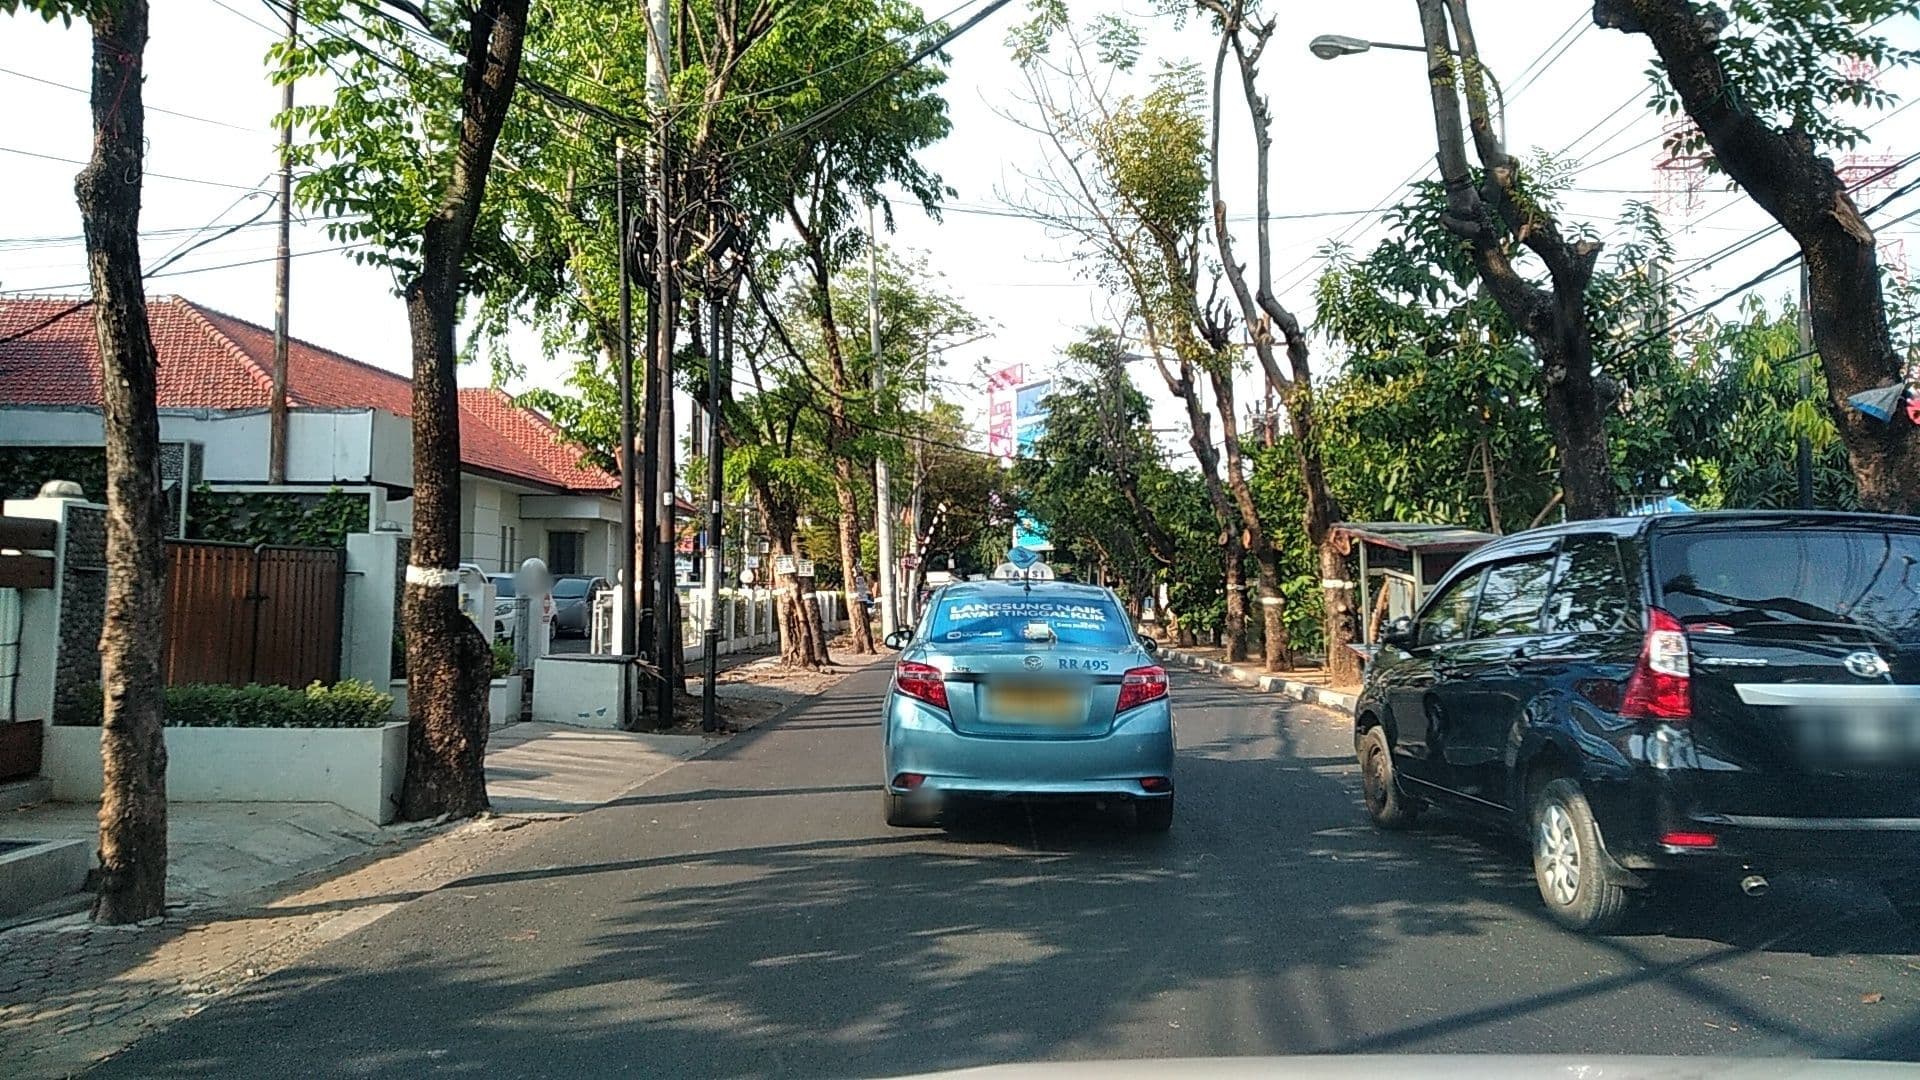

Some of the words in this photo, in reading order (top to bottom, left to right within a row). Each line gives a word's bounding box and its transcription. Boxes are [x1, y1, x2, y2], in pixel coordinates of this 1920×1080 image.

[950, 603, 1053, 613] LANGSUNG
[1056, 604, 1104, 615] NAIK
[1001, 609, 1069, 618] TINGGAL
[1070, 612, 1106, 622] KLIK
[1058, 658, 1078, 671] RR
[1081, 658, 1109, 671] 495
